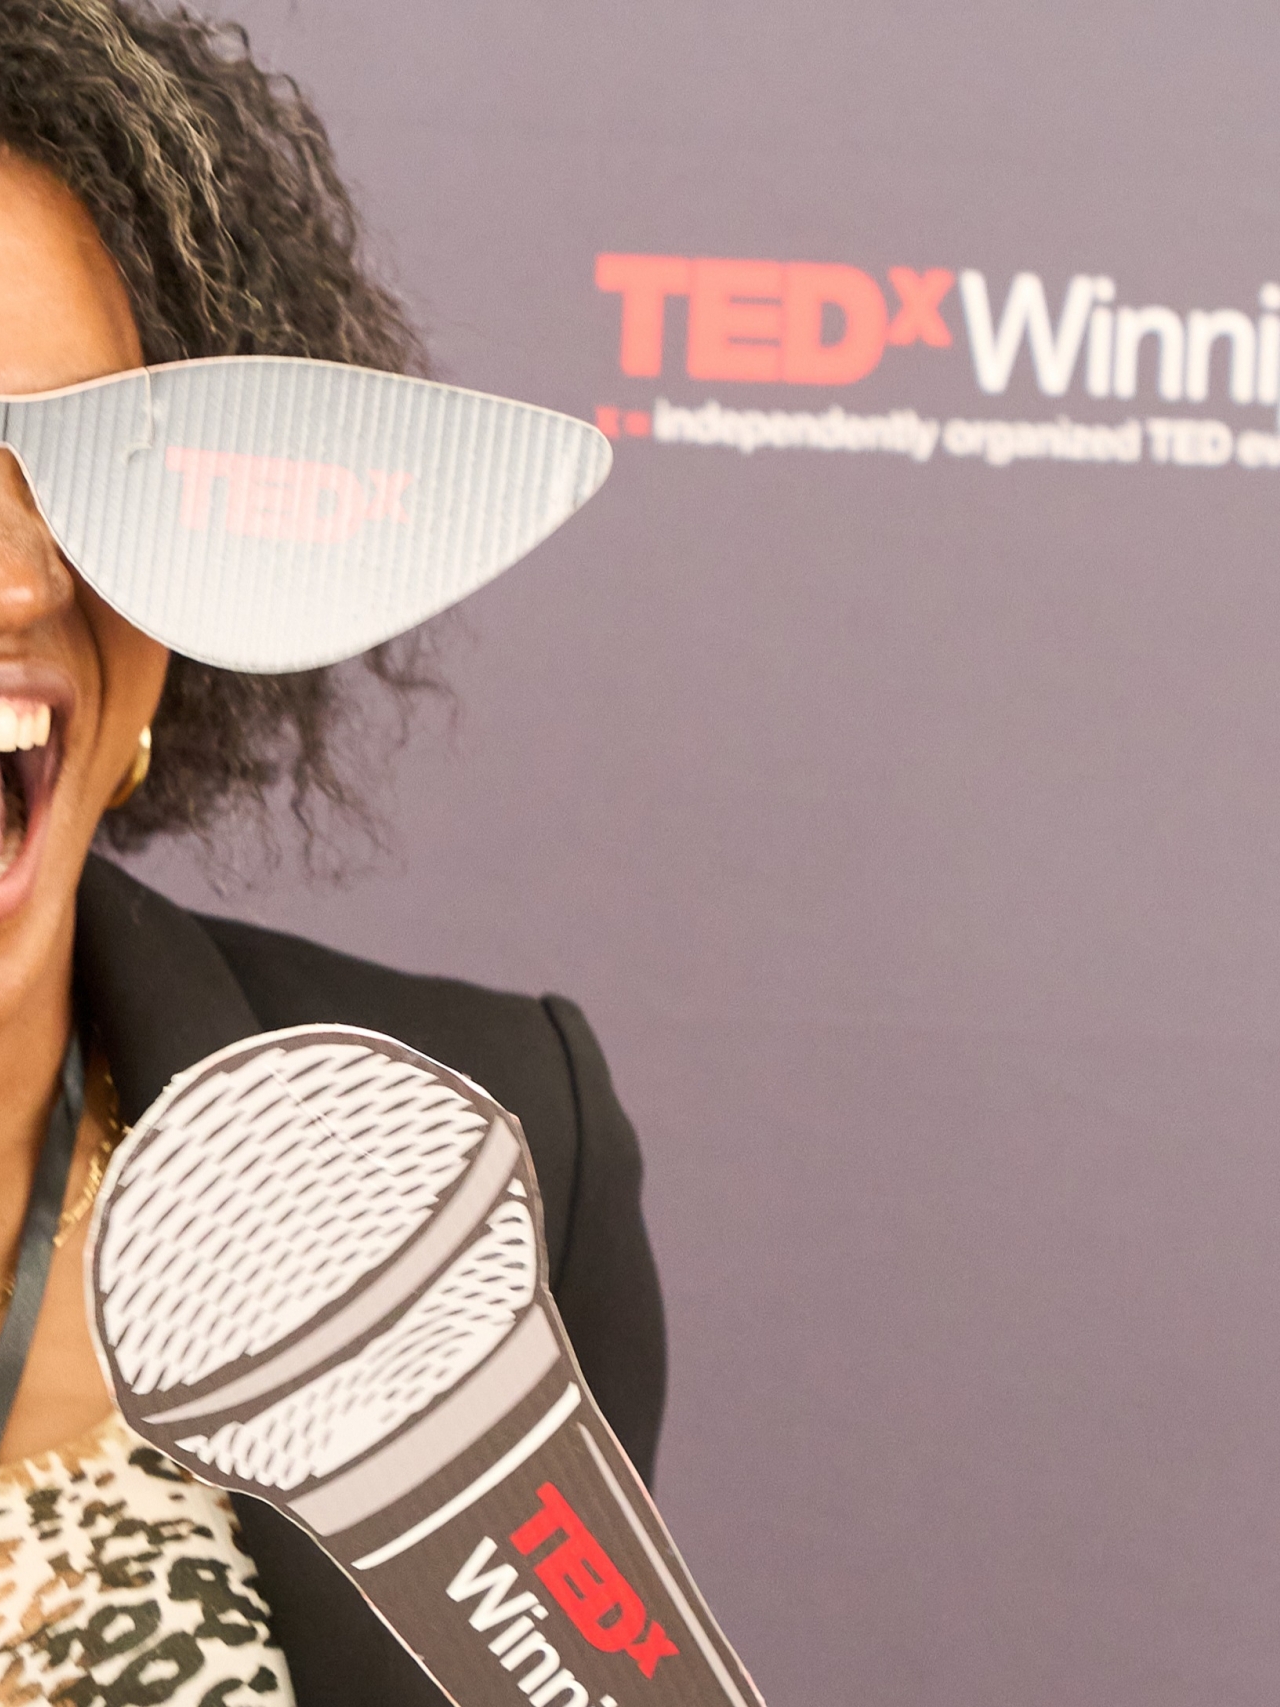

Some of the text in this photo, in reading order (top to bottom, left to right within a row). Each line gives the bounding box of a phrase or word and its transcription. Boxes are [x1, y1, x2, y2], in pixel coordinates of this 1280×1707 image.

[164, 445, 415, 544] TEDx
[1145, 416, 1233, 466] TED
[445, 1535, 619, 1707] Winn
[509, 1480, 681, 1681] TEDx
